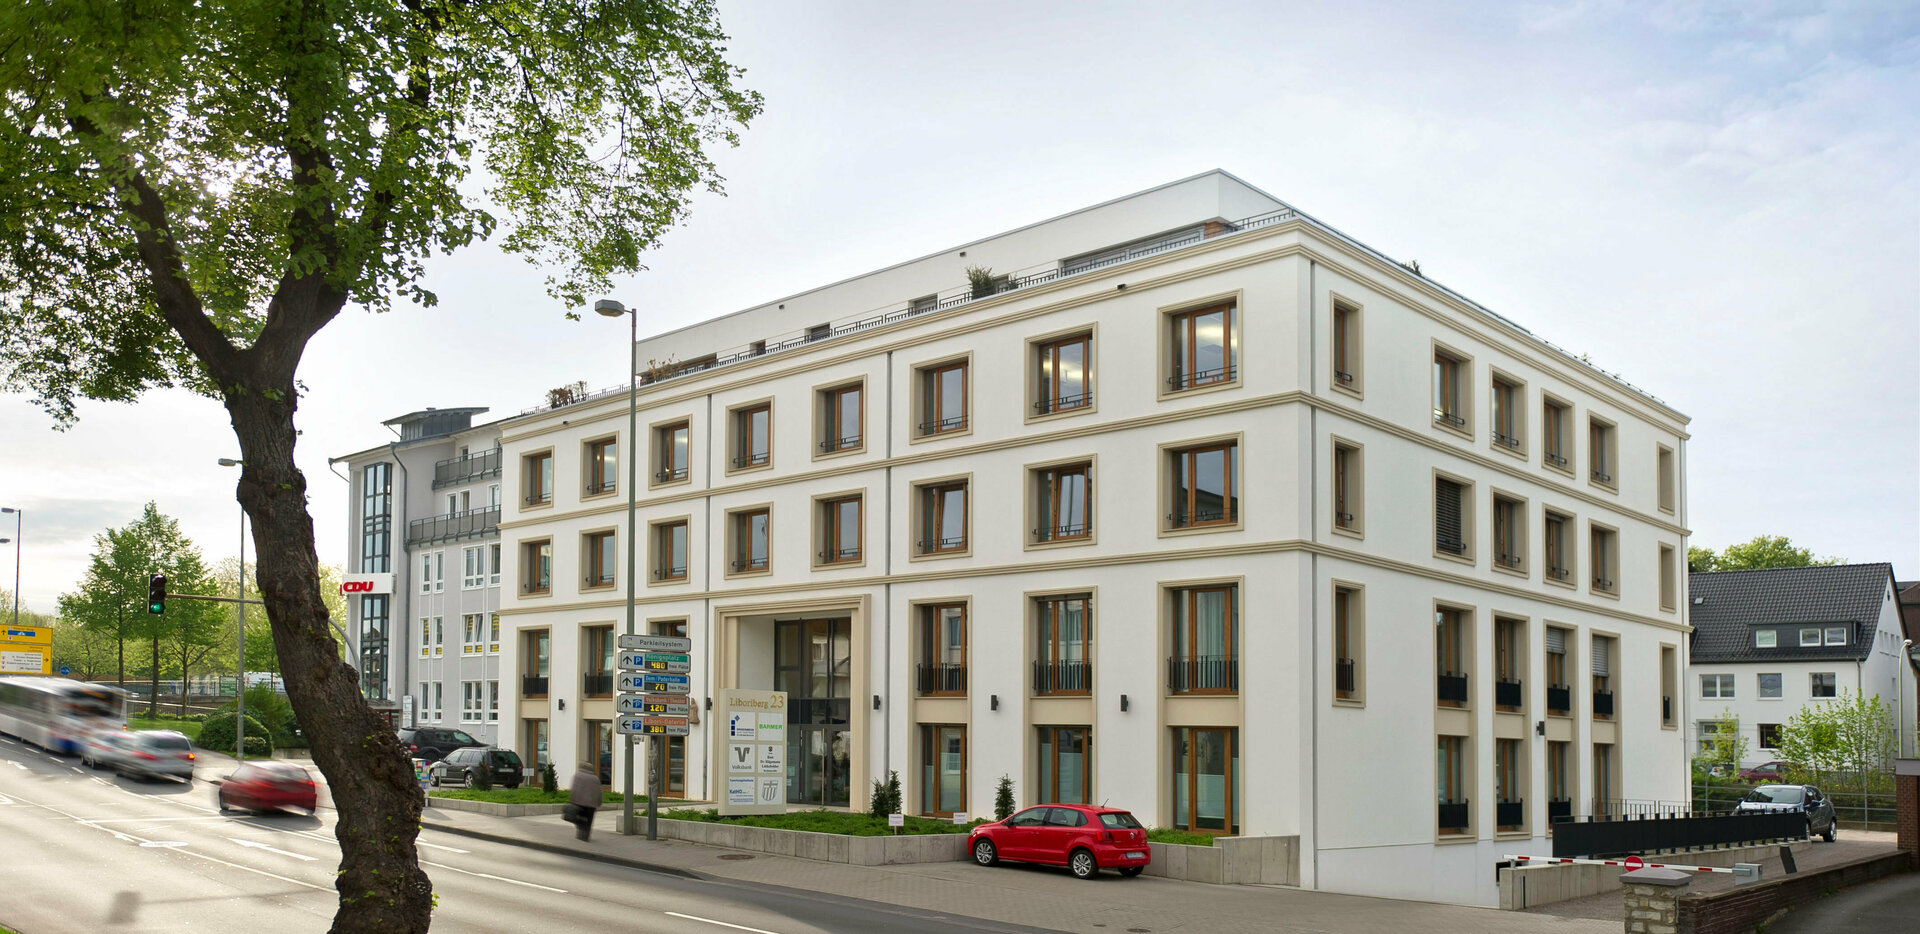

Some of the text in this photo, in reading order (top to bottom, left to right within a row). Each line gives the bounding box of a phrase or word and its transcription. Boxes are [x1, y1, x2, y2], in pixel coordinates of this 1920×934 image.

[343, 581, 374, 592] CDU
[635, 656, 642, 664] P
[651, 661, 666, 669] 480
[635, 678, 641, 686] P
[655, 683, 665, 691] 70
[729, 694, 784, 709] Liboriberg 23
[650, 704, 665, 712] 120
[650, 725, 665, 733] 380
